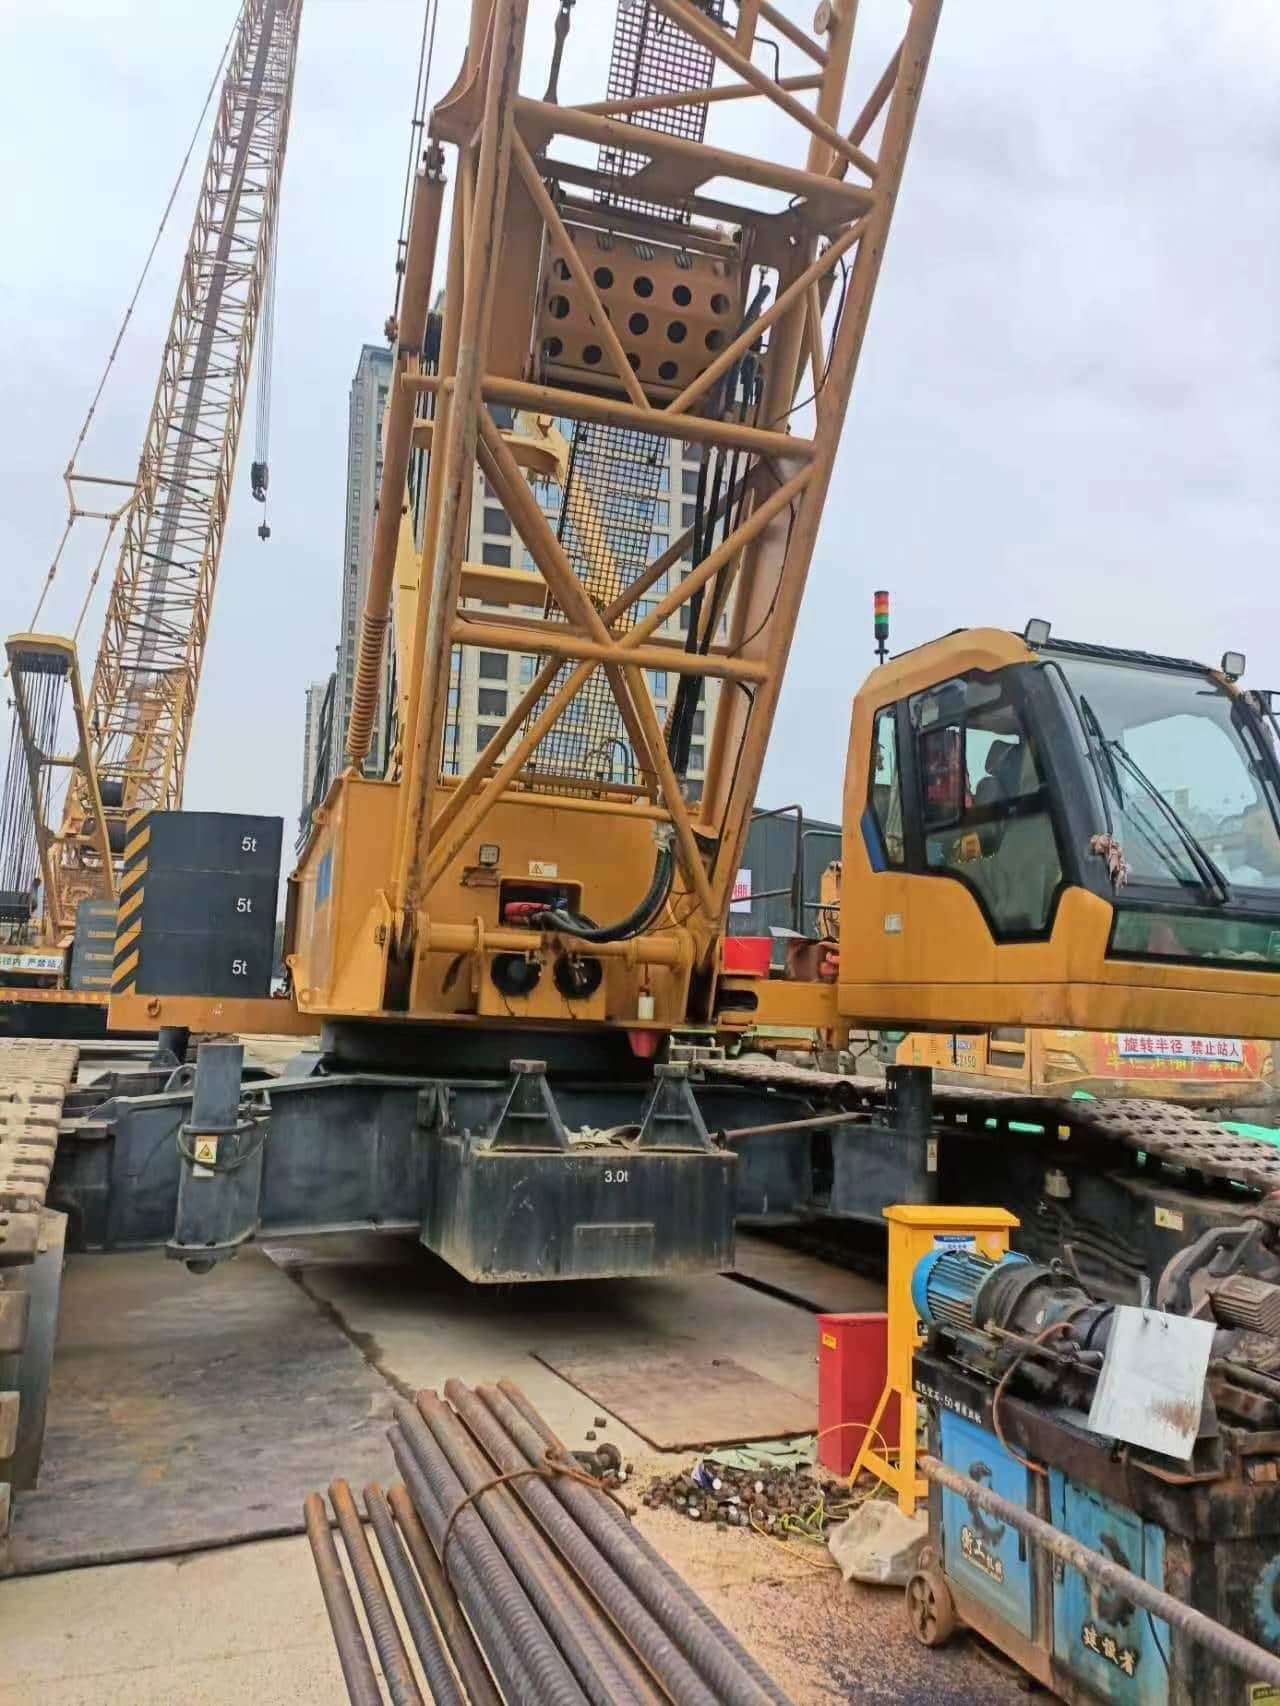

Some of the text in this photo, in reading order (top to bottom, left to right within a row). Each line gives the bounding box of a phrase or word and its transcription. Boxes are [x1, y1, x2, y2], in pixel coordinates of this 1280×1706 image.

[241, 836, 257, 852] 5t
[236, 898, 252, 912] 5t
[231, 959, 248, 975] 5t
[1123, 1037, 1239, 1057] 旋转半径 禁止站人
[604, 1169, 629, 1183] 3.0t
